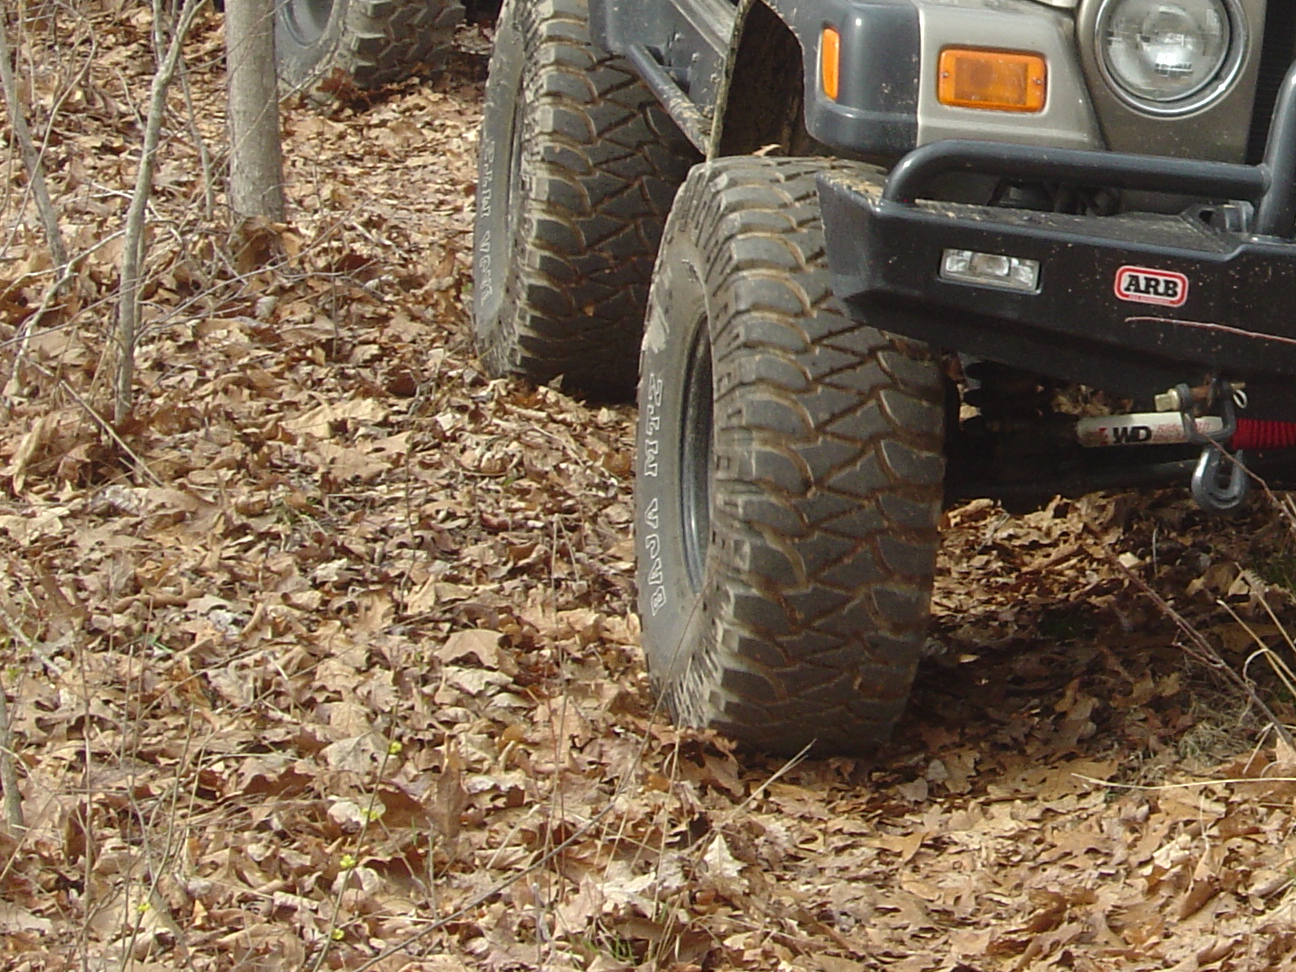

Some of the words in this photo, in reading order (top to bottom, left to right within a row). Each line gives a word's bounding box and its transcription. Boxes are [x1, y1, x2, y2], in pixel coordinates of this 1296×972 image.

[1123, 273, 1179, 298] ARB
[643, 372, 663, 478] MTZ
[645, 497, 667, 616] BAJA
